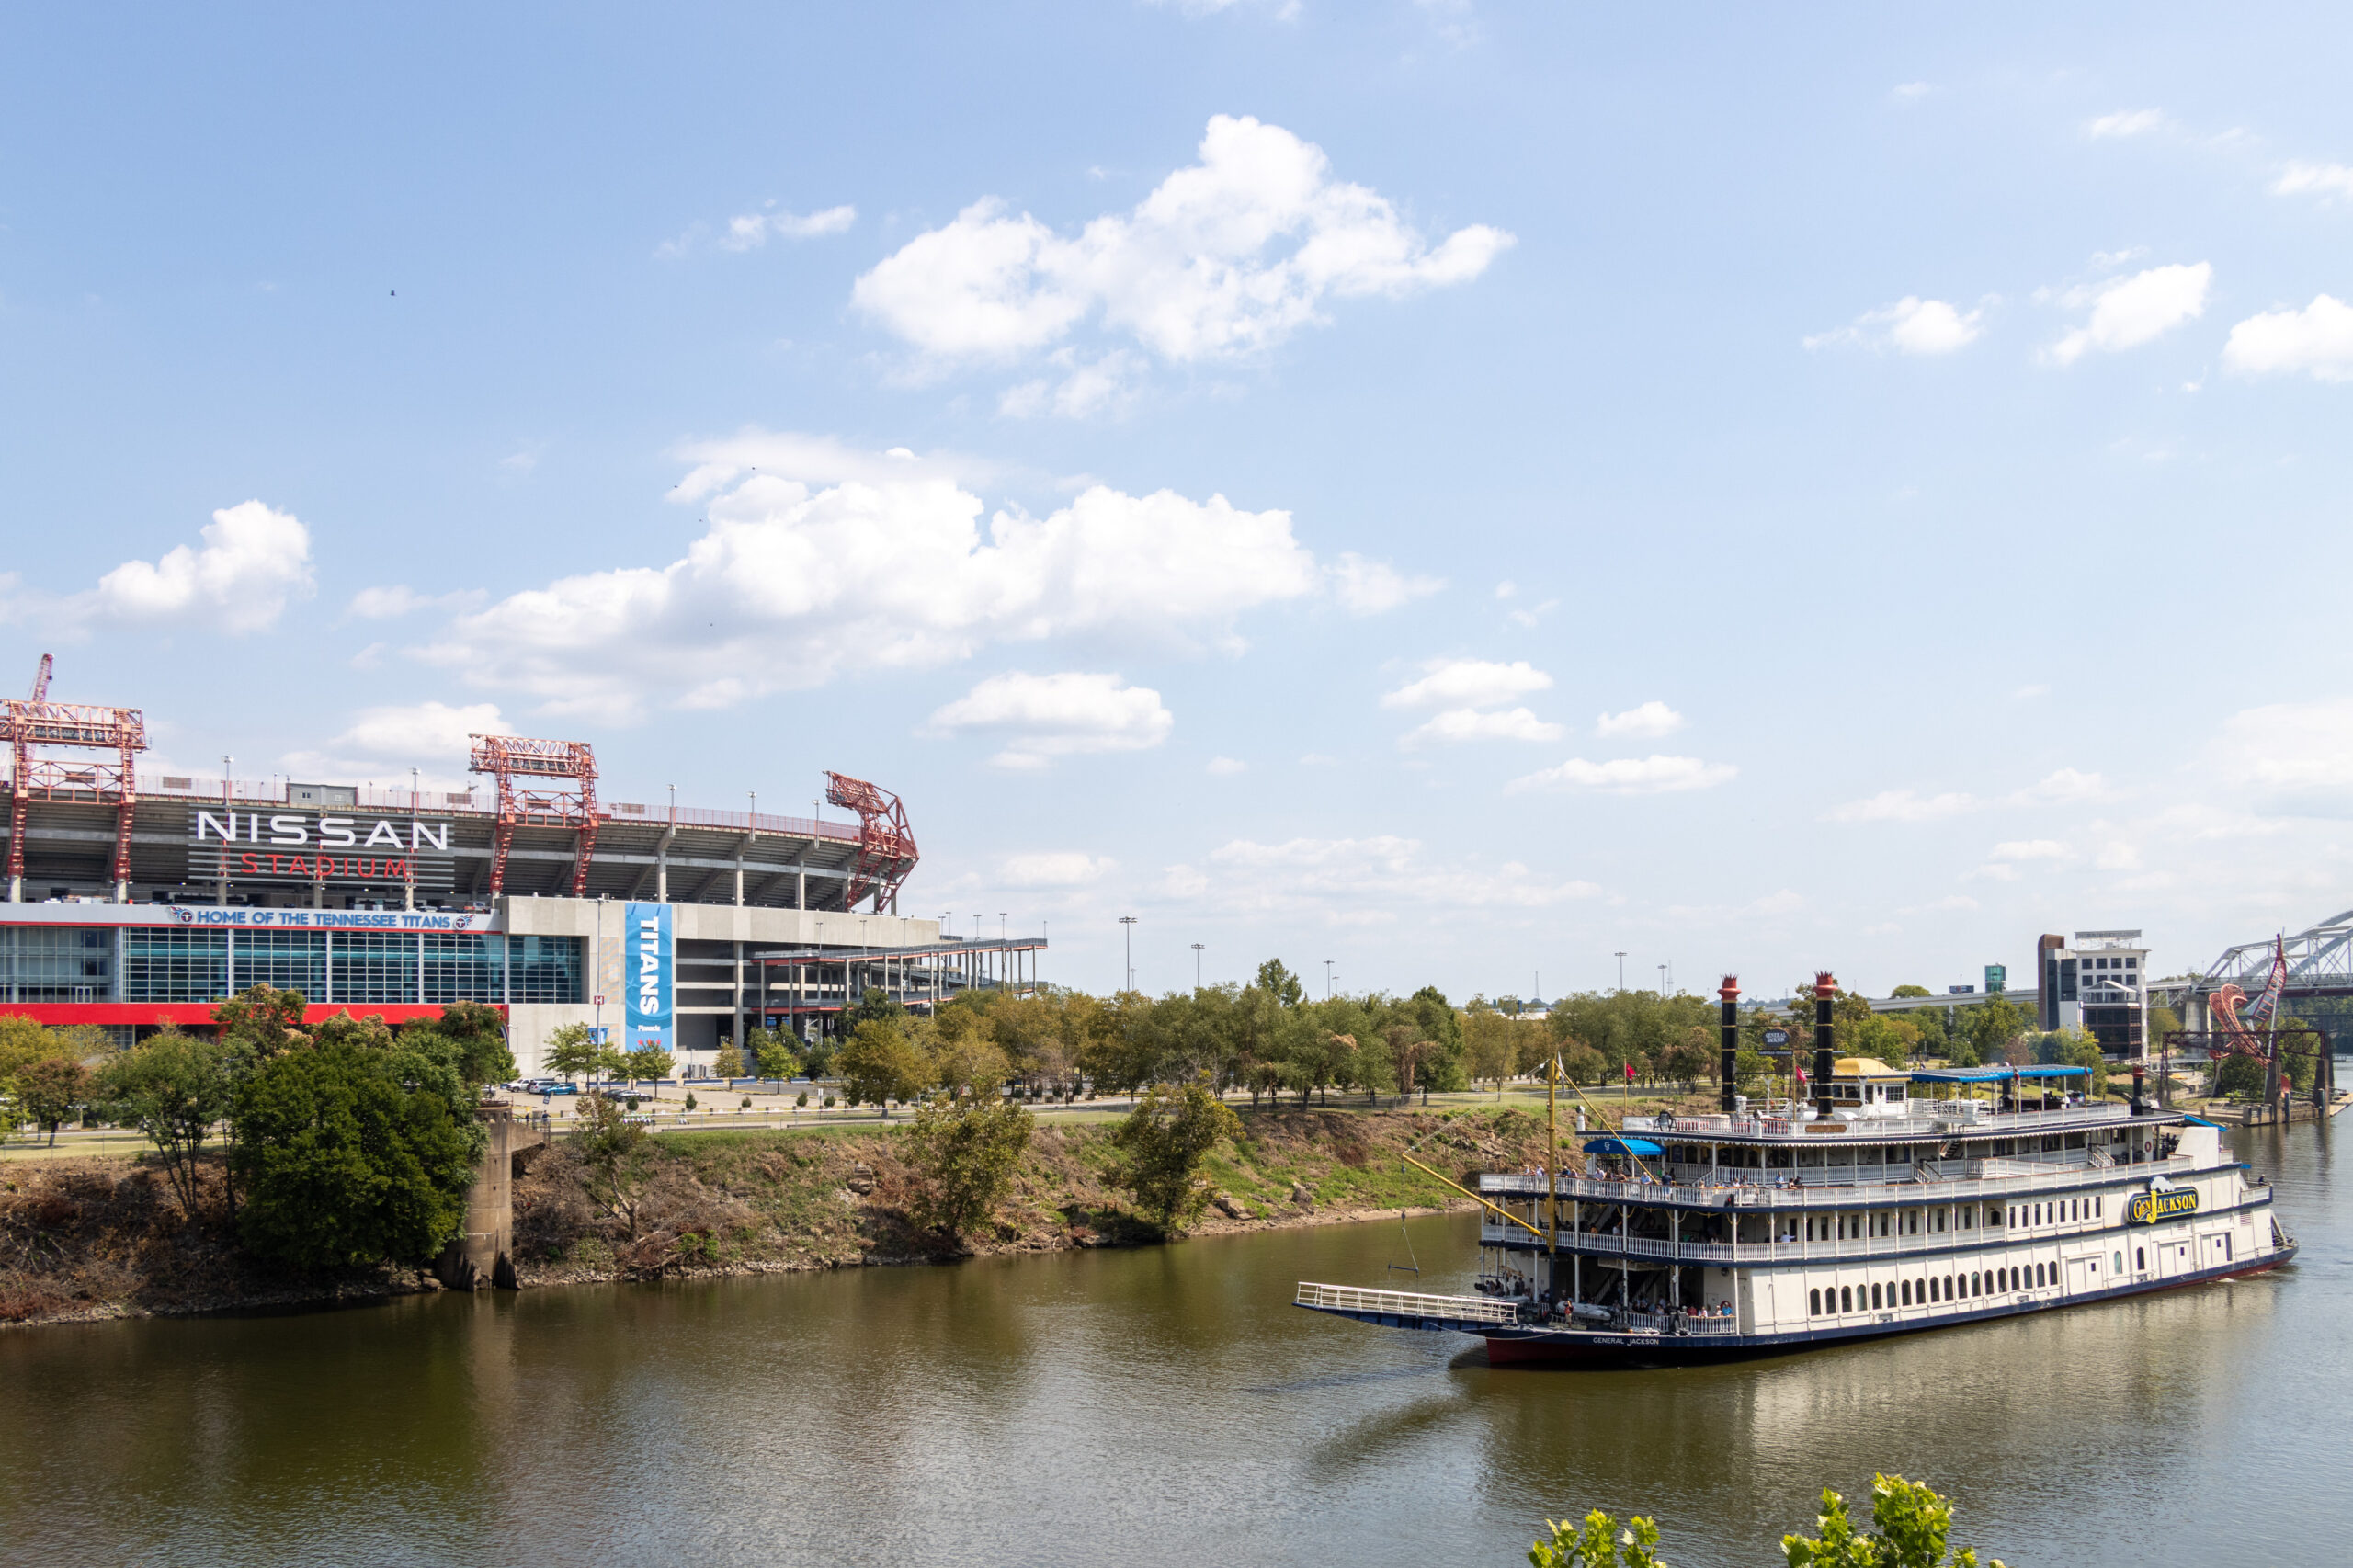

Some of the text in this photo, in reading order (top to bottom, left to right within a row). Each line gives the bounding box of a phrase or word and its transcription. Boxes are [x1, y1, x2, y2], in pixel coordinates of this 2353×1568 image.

[197, 811, 448, 850] NISSAN
[241, 853, 409, 879] STADIUM
[198, 911, 450, 928] HOME OF THE TENNESSEE TITANS
[640, 916, 659, 1015] TITANS
[2146, 1190, 2197, 1224] JACKSON
